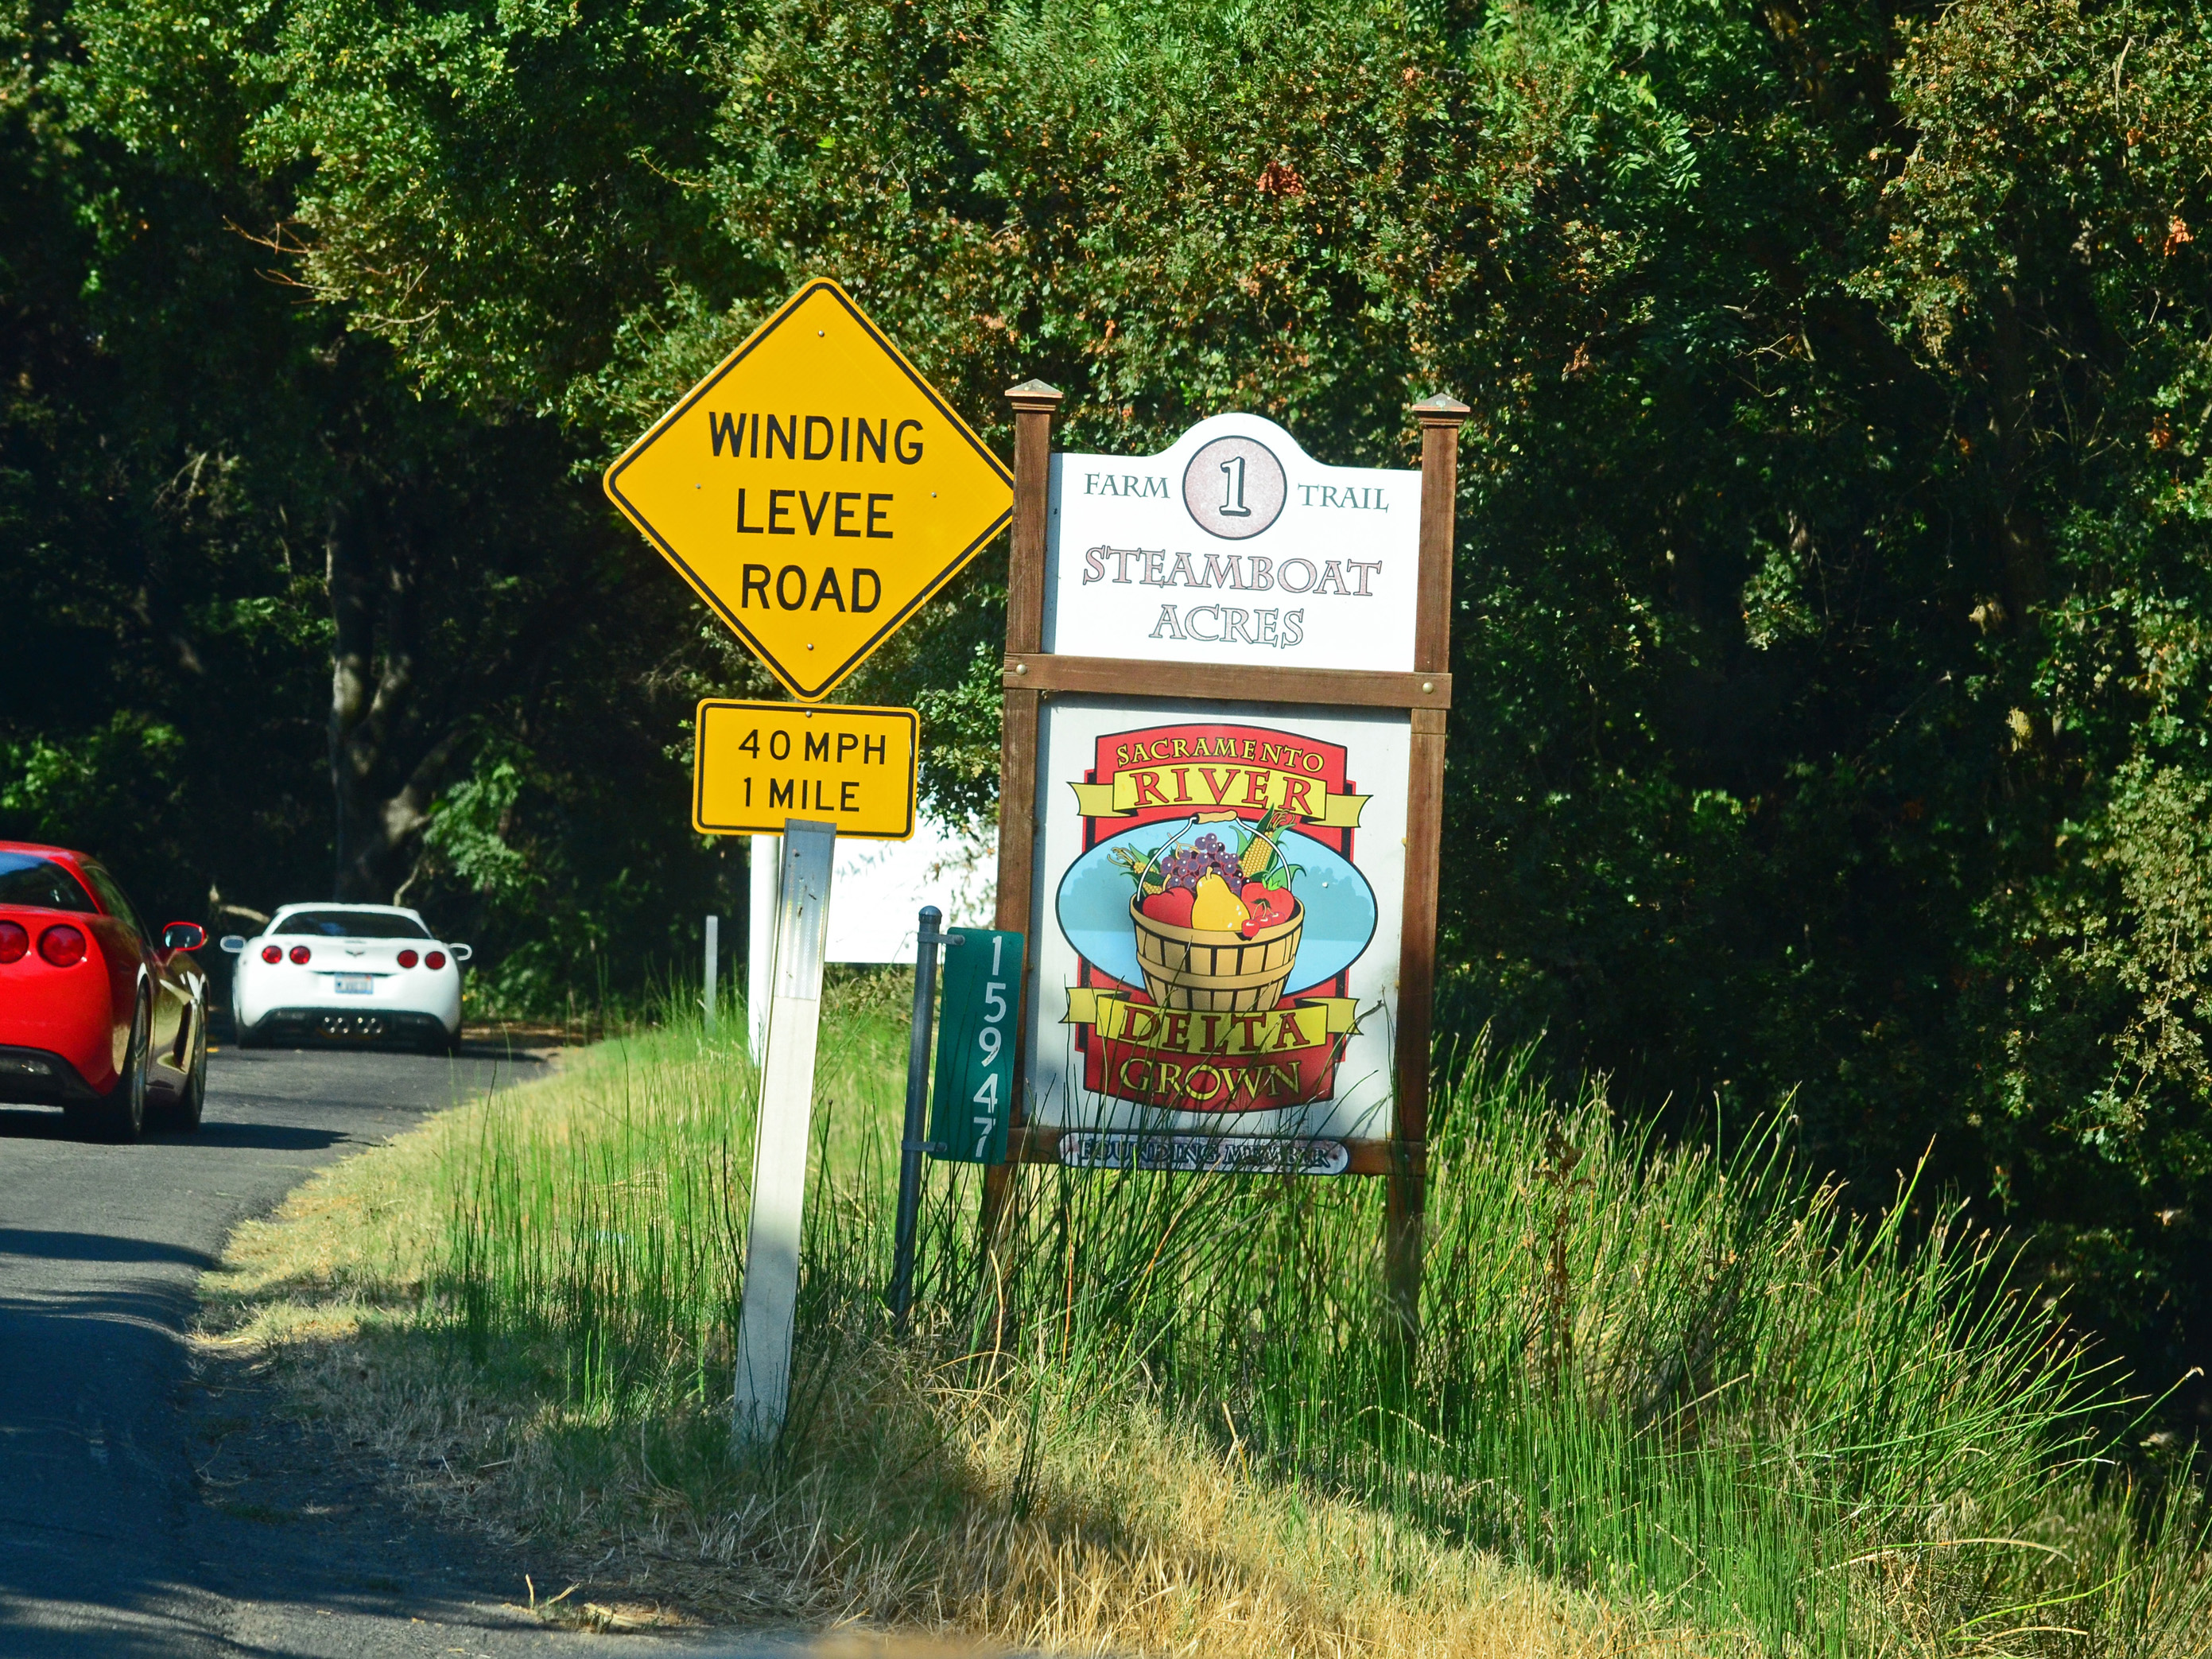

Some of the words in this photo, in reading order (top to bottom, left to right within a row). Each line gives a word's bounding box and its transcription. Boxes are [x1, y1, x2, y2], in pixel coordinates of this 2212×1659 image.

[709, 411, 924, 464] WINDING
[1084, 473, 1170, 499] FARM
[1219, 456, 1251, 517] 1
[1298, 484, 1389, 513] TRAIL
[736, 488, 894, 539] LEVEE
[741, 564, 881, 613] ROAD
[1083, 545, 1382, 596] STEAMBOAT
[1149, 604, 1304, 649] ACRES
[738, 730, 791, 760] 40
[804, 732, 887, 766] MPH
[1116, 737, 1325, 772] SACRAMENTO
[743, 778, 752, 807] 1
[769, 779, 860, 812] MILE
[1129, 767, 1312, 815] RIVER
[972, 935, 1007, 1158] 15947
[1120, 1004, 1310, 1055] DELTA
[1120, 1058, 1301, 1101] GROWN
[1078, 1140, 1220, 1164] FOUNDING
